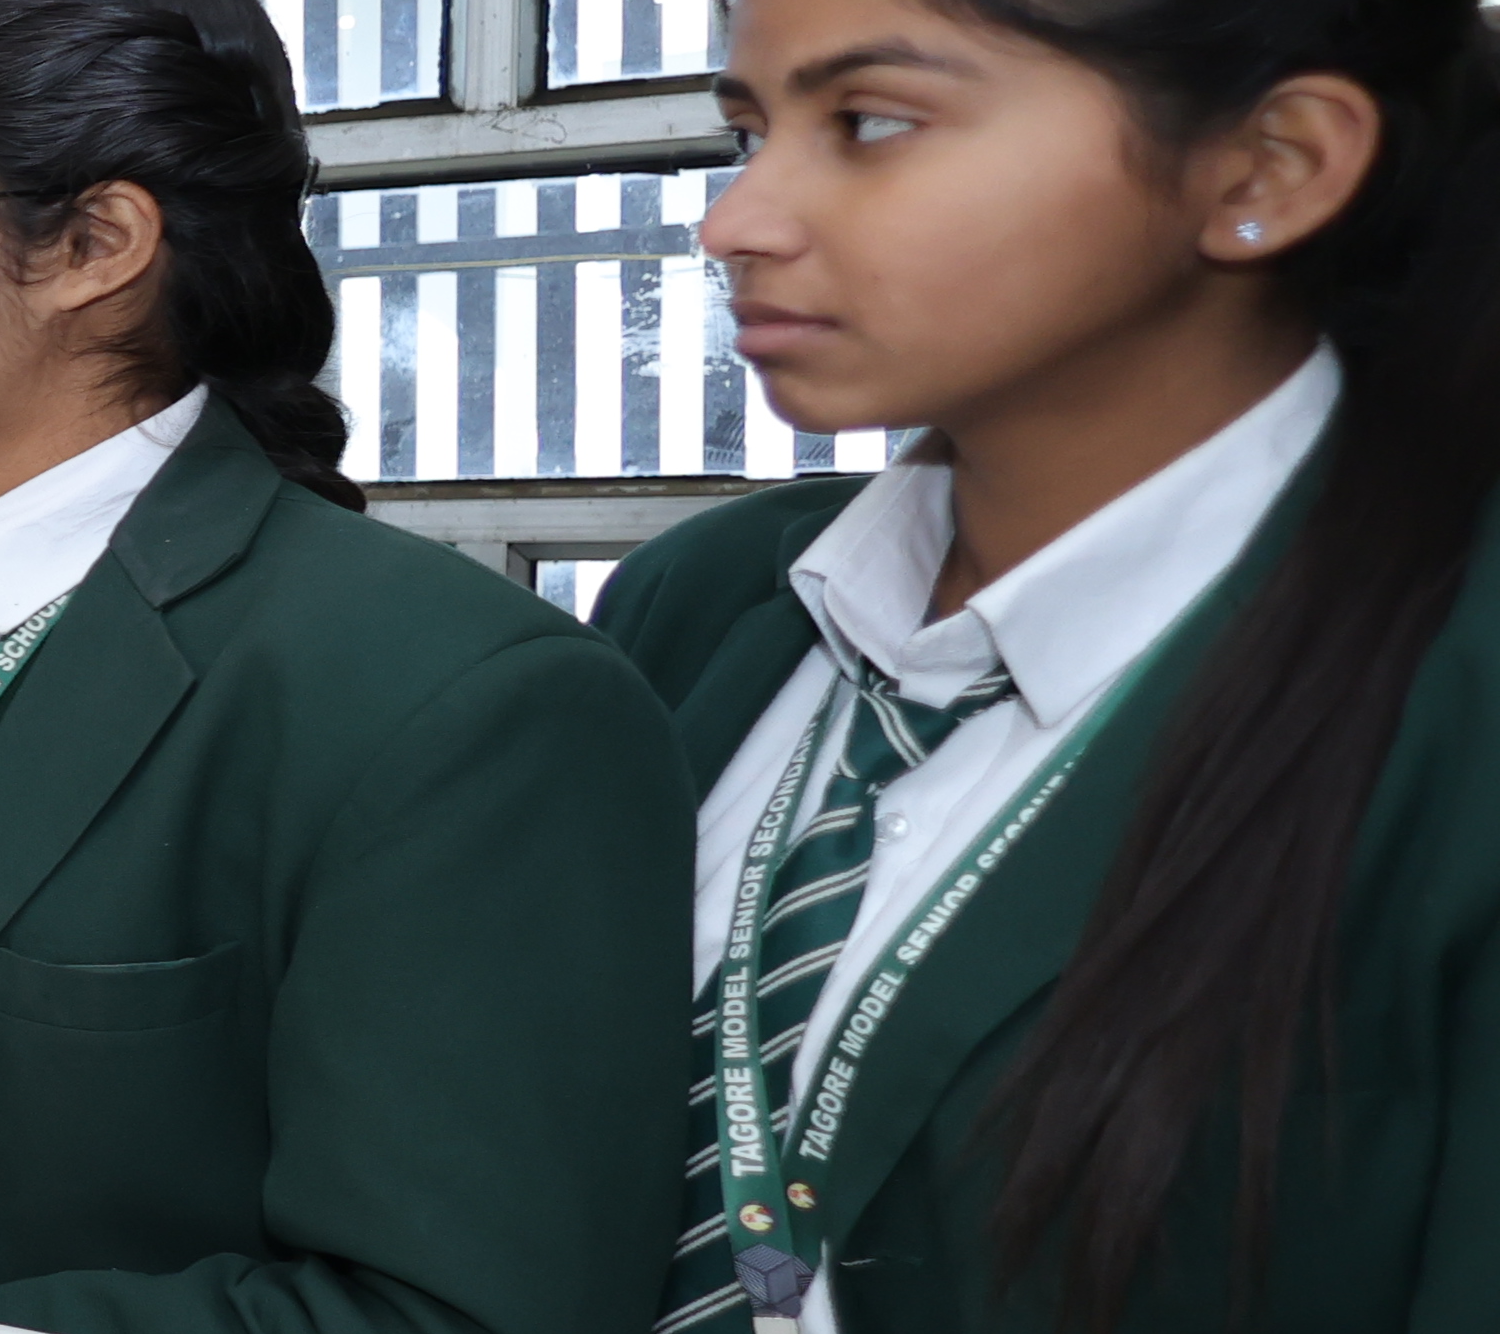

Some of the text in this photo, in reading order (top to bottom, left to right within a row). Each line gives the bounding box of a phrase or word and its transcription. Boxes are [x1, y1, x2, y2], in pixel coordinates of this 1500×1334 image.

[728, 861, 767, 961] SENIOR
[722, 965, 750, 1061] MODEL
[799, 1059, 855, 1162] TAGORE
[838, 971, 904, 1060] MODEL
[725, 1064, 767, 1178] TAGORE
